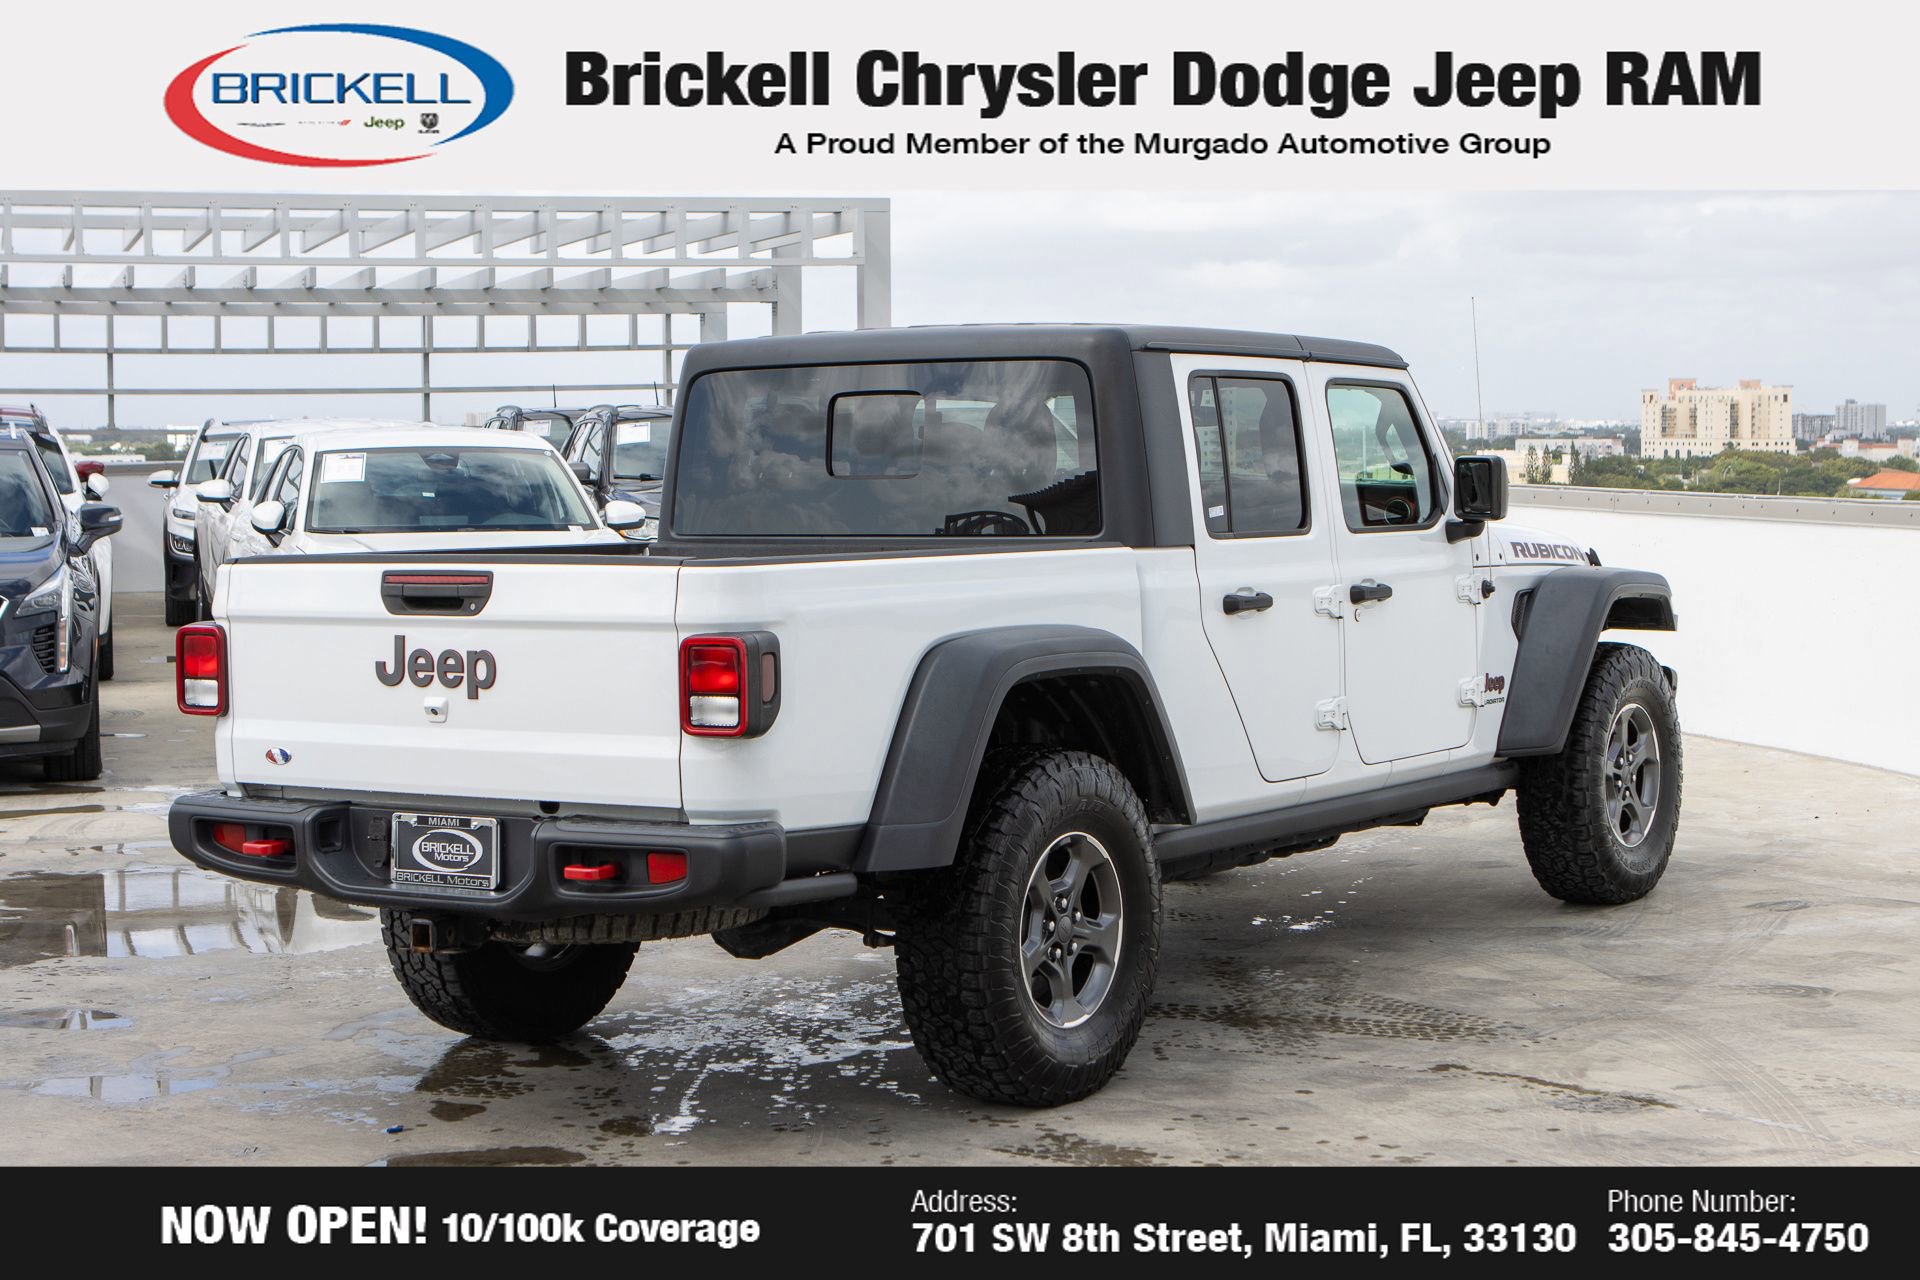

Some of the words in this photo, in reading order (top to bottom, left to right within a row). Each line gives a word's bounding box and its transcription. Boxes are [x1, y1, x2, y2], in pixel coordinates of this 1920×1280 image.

[1510, 541, 1586, 562] RUBICON
[374, 634, 497, 701] Jeep
[1484, 672, 1505, 694] Jeep
[428, 817, 460, 827] MIAMI
[421, 841, 474, 855] BRICKELL
[434, 852, 469, 863] Motors
[396, 871, 444, 884] BRICKELL
[446, 875, 490, 887] Motors
